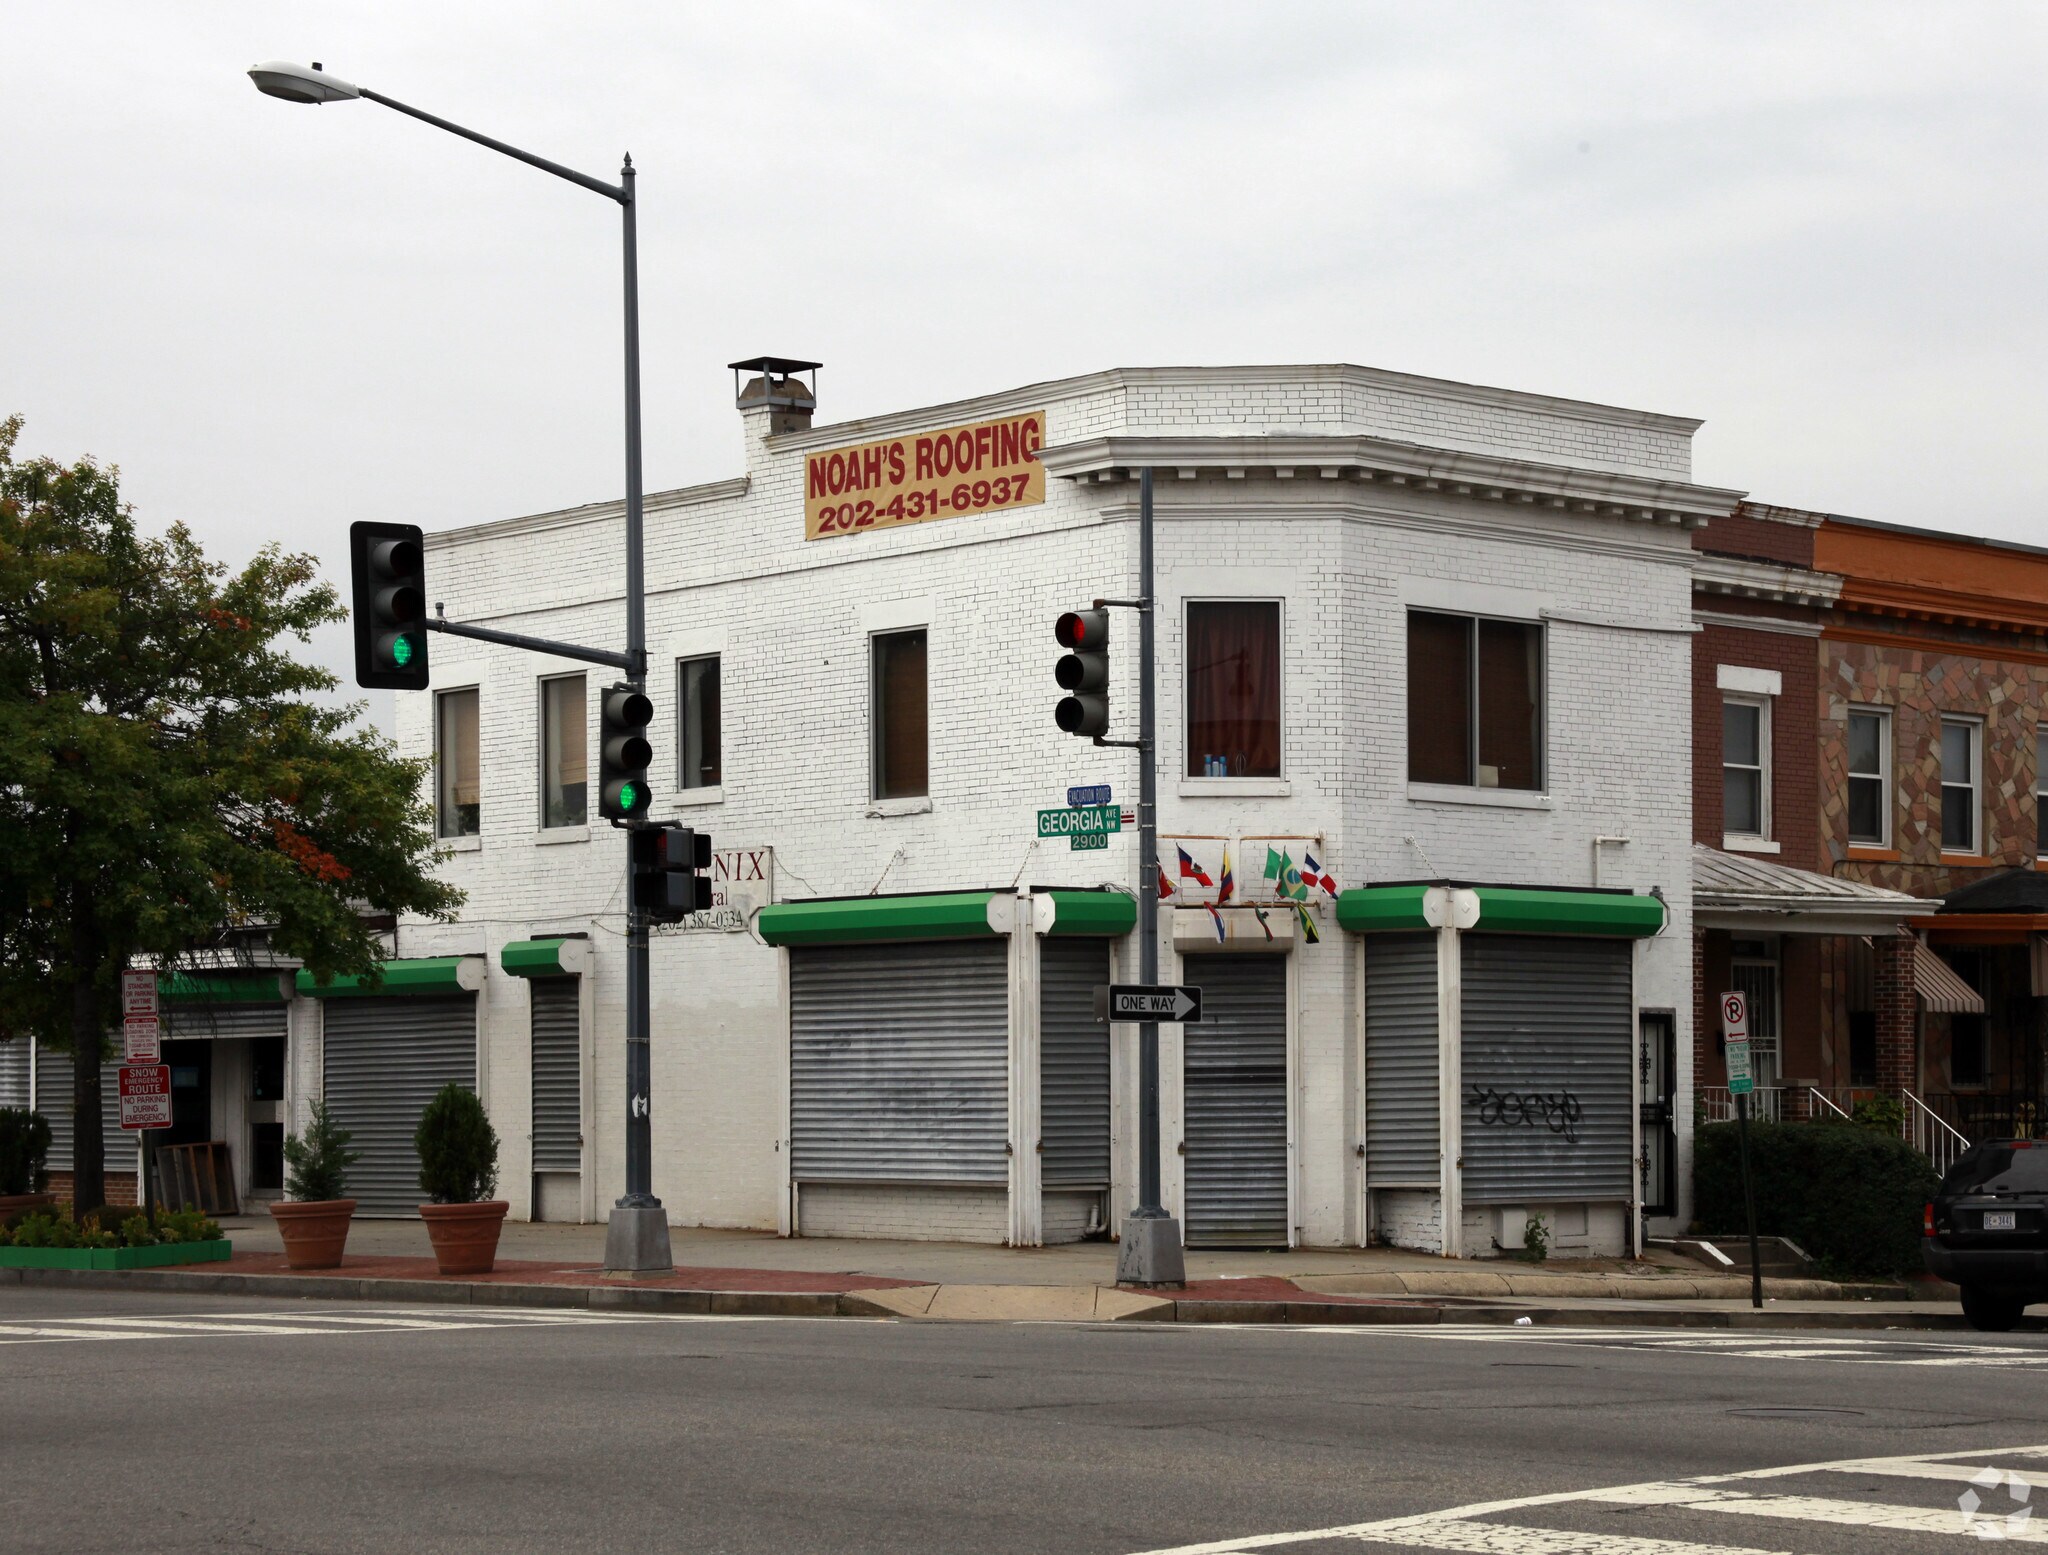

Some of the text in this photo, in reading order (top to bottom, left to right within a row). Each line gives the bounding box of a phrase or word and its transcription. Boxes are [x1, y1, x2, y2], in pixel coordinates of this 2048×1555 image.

[809, 418, 1040, 499] NOAH'S ROOFING
[818, 473, 1030, 533] 202-431-6937
[1069, 787, 1110, 803] EVACUATION ROUTE
[1040, 808, 1117, 833] GEORGIA AVE
[1106, 820, 1116, 830] NW
[1072, 833, 1107, 849] 2900
[1121, 995, 1176, 1011] ONE WAY
[129, 1067, 158, 1078] SNOW
[124, 1076, 164, 1085] EMERGENCY
[128, 1084, 161, 1094] ROUTE
[124, 1095, 166, 1105] NO PARKING
[132, 1104, 159, 1113] DURING
[125, 1113, 167, 1122] EMERGENCY
